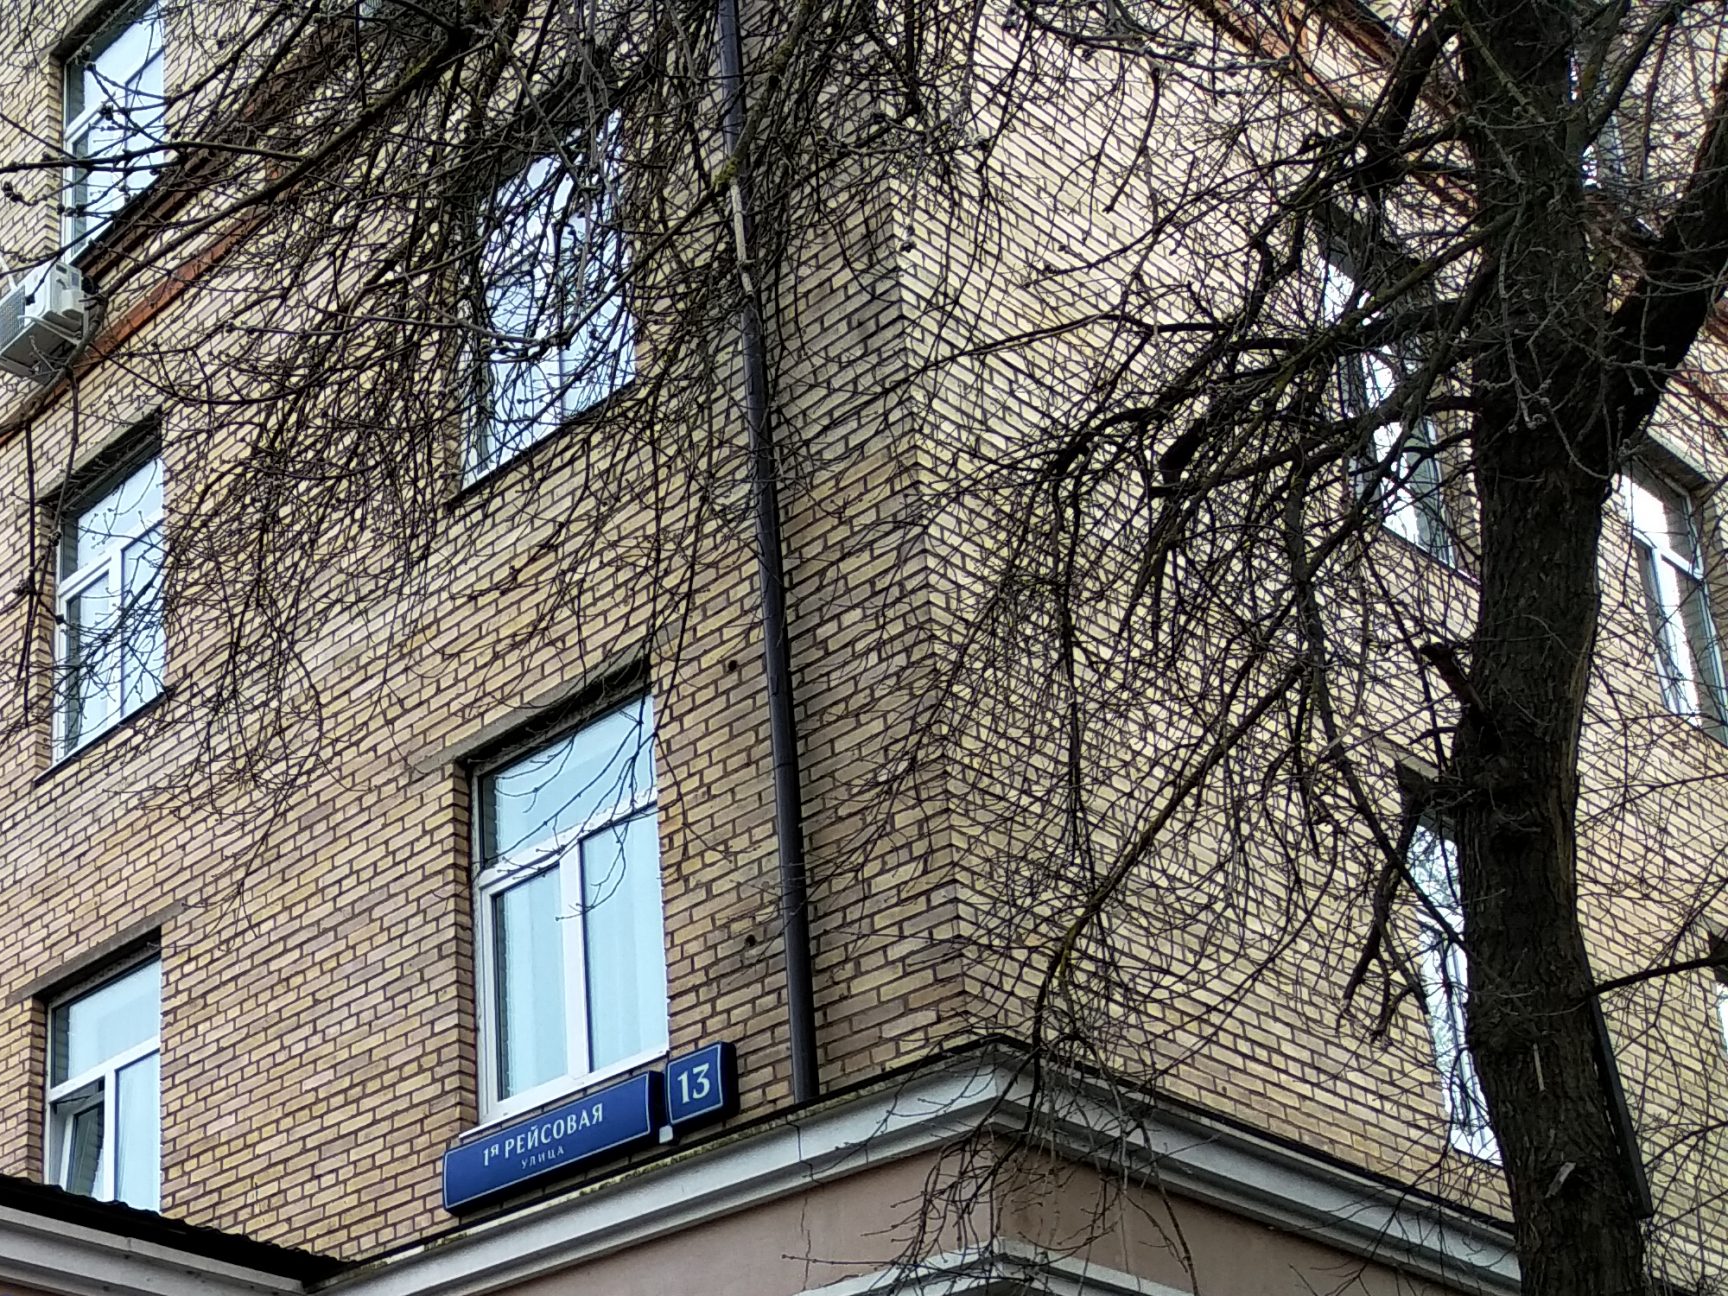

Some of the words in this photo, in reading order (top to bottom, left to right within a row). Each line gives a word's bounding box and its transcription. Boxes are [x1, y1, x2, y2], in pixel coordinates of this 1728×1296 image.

[677, 1062, 711, 1104] 13
[504, 1103, 603, 1159] РЕЙСОВАЯ
[521, 1146, 565, 1169] УЛИЦА
